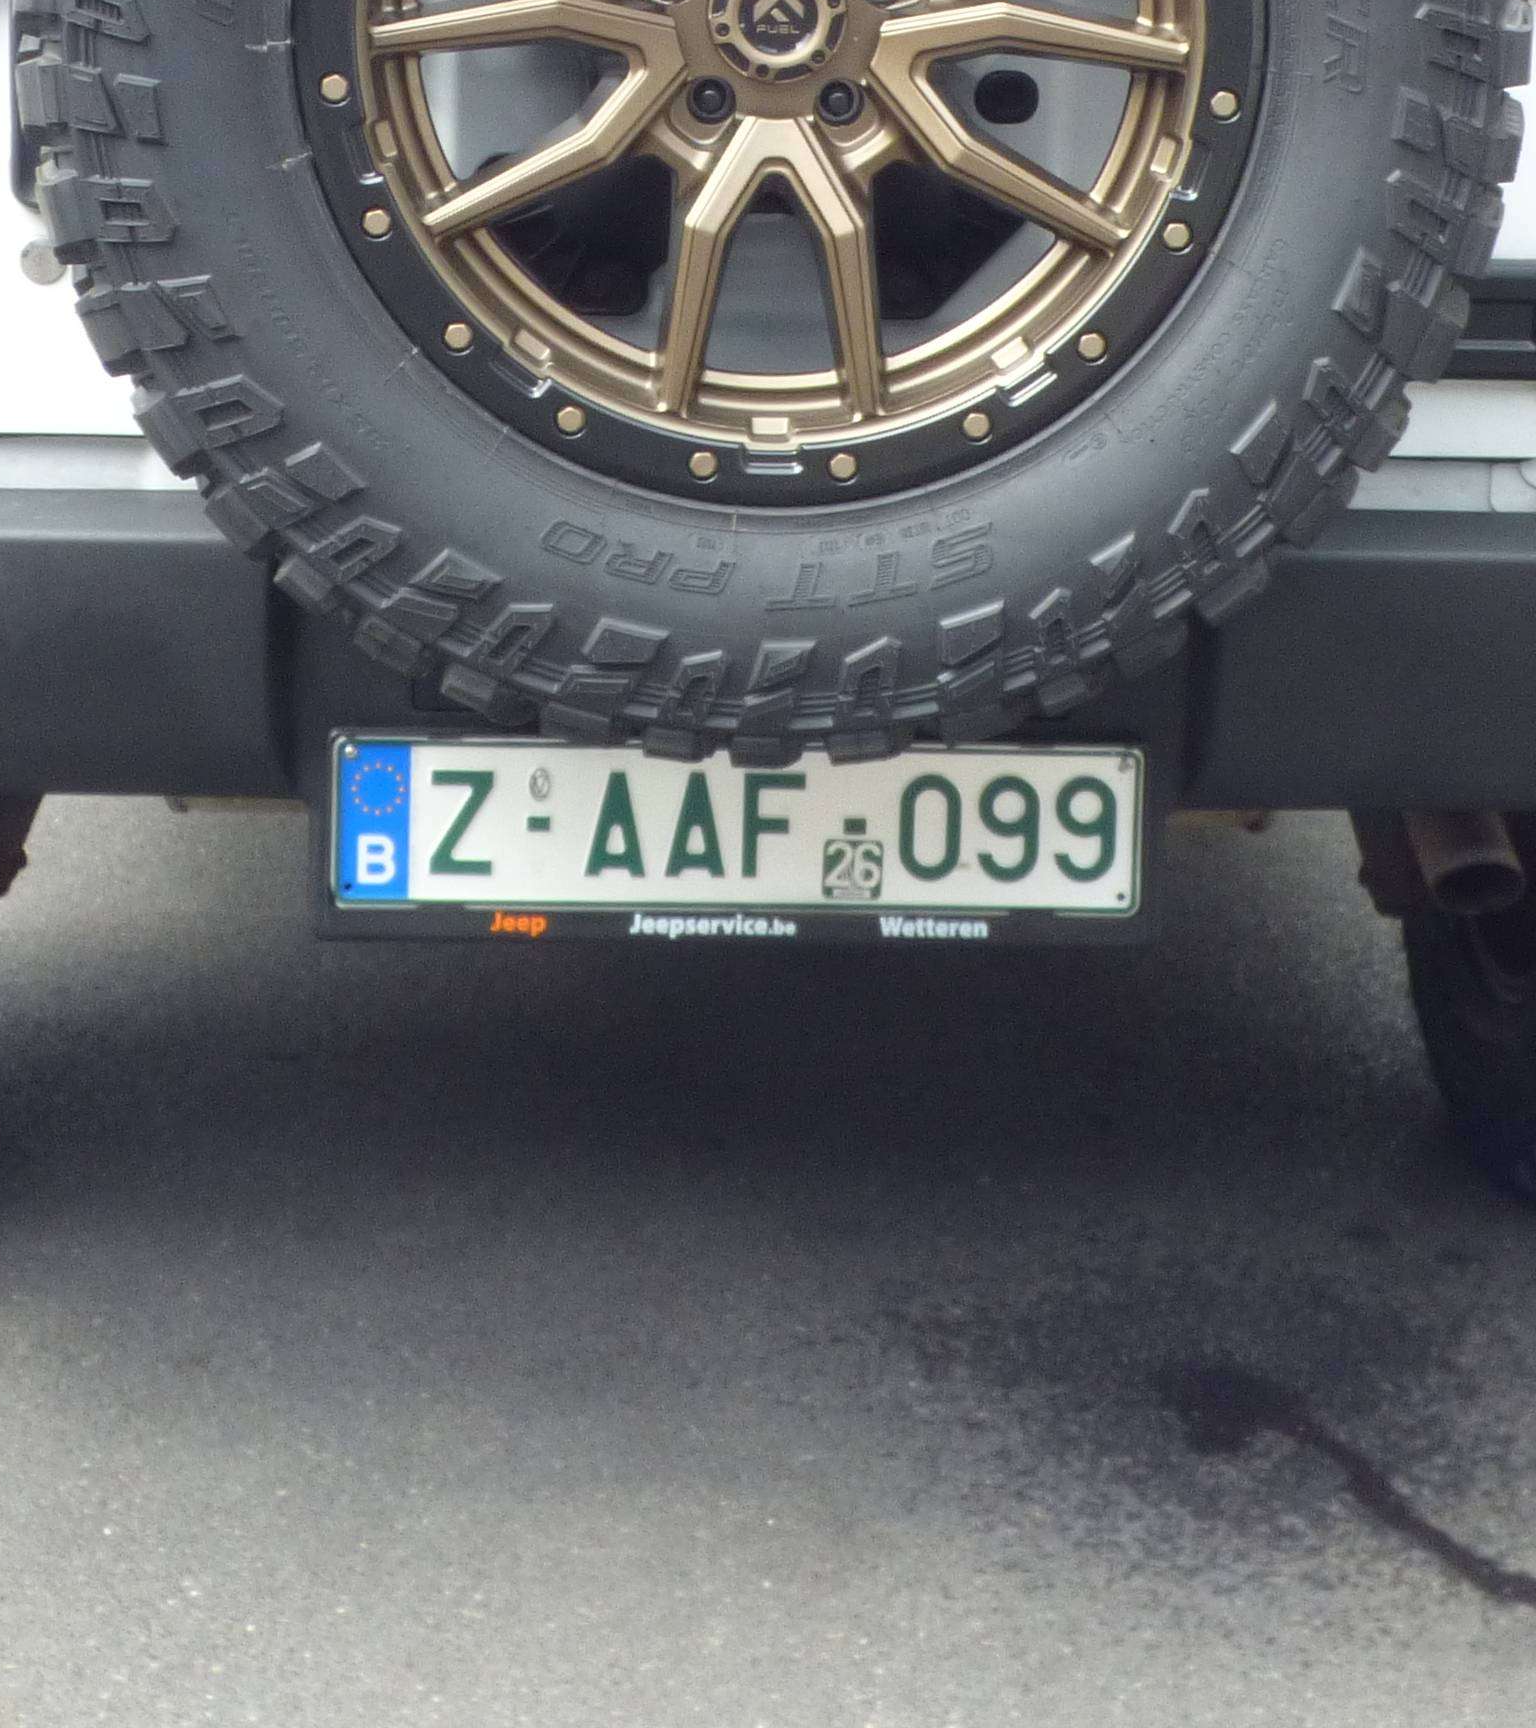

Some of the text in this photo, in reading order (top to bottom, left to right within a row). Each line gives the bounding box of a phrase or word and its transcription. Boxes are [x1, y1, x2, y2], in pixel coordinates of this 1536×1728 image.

[756, 24, 800, 34] FUEL
[540, 520, 737, 595] PRO
[764, 521, 994, 611] STT
[357, 835, 396, 884] B
[824, 841, 881, 888] 26
[490, 912, 988, 939] Jeep Jeepservice.be Wetteren
